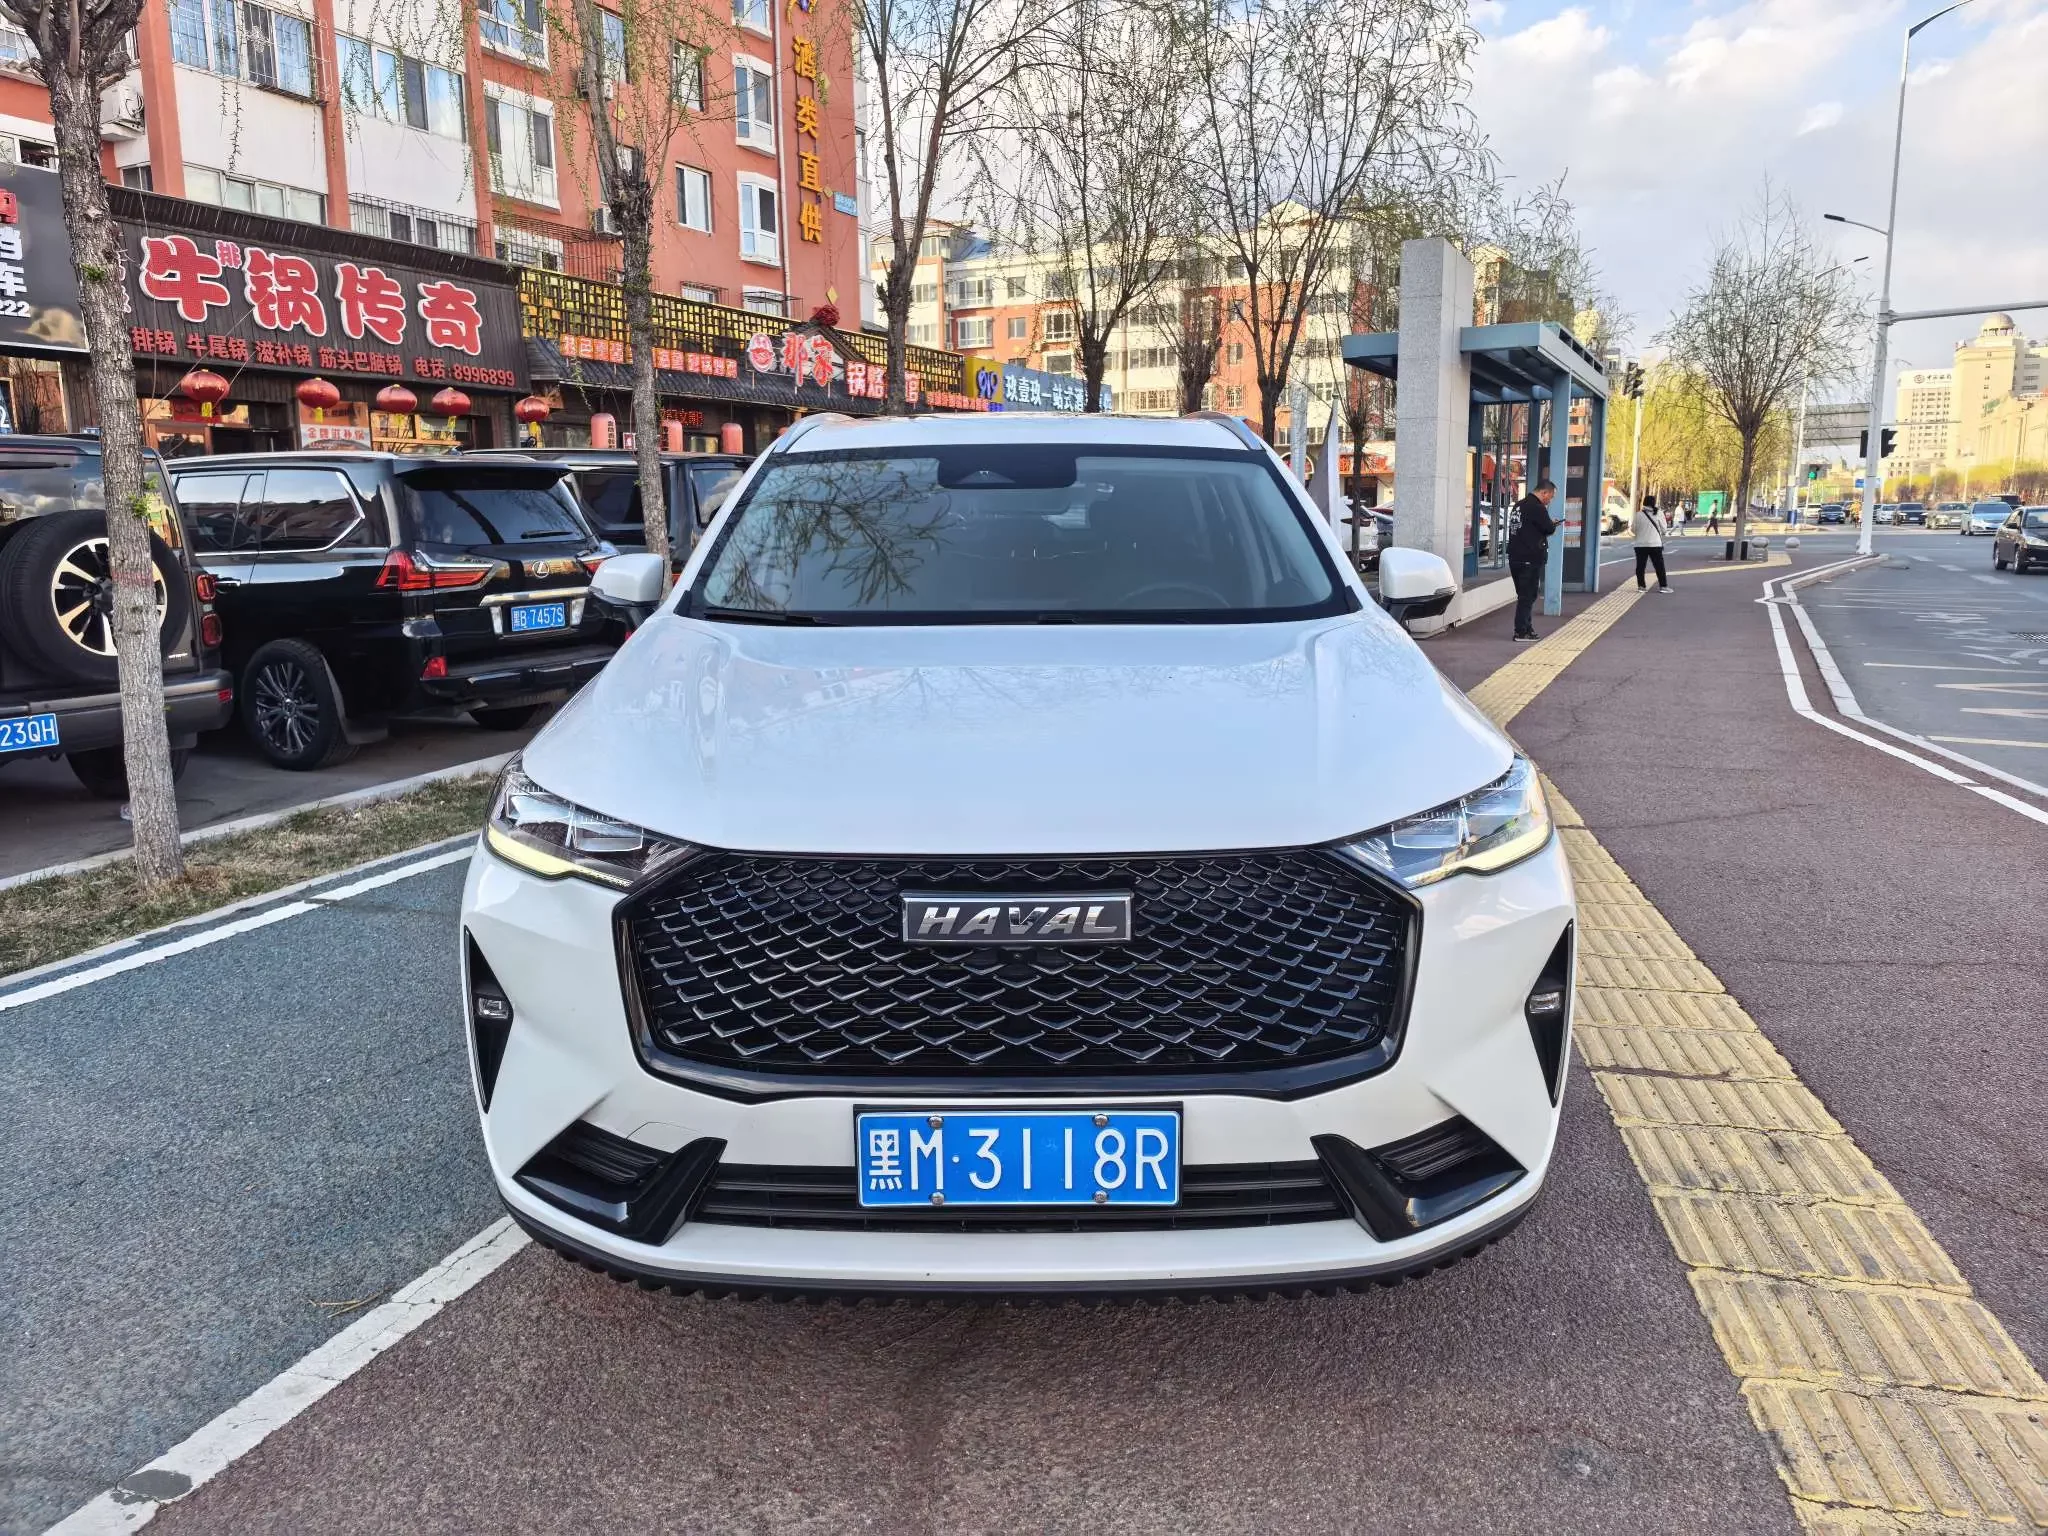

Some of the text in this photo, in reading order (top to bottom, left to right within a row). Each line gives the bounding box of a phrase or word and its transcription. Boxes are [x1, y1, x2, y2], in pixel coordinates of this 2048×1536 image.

[793, 35, 823, 244] 酒类直供
[186, 332, 249, 362] 牛尾锅
[256, 340, 313, 367] 滋补锅
[319, 346, 404, 376] 筋头巴脑锅
[0, 718, 57, 747] 23QH
[917, 906, 1118, 935] HAVAL
